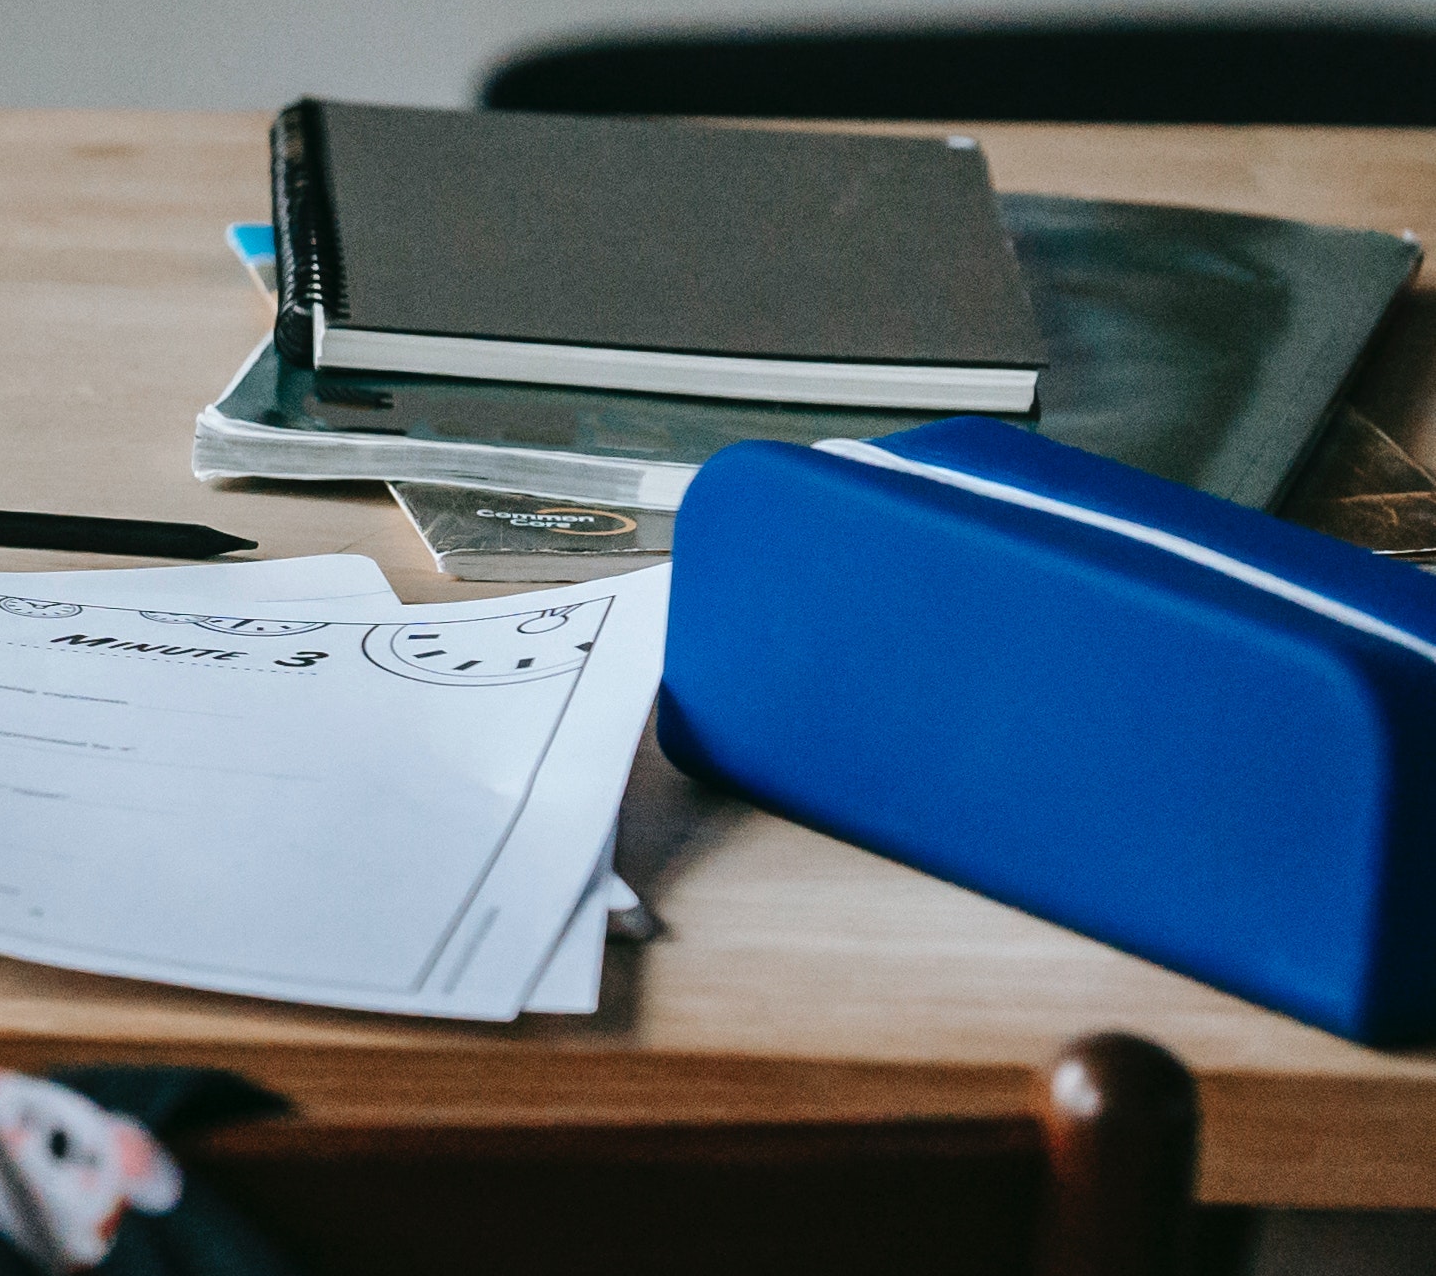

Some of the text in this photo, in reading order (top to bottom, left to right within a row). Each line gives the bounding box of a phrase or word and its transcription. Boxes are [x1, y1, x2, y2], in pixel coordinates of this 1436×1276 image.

[475, 508, 595, 523] Common
[509, 518, 571, 528] Core
[50, 634, 330, 668] MINUTE 3
